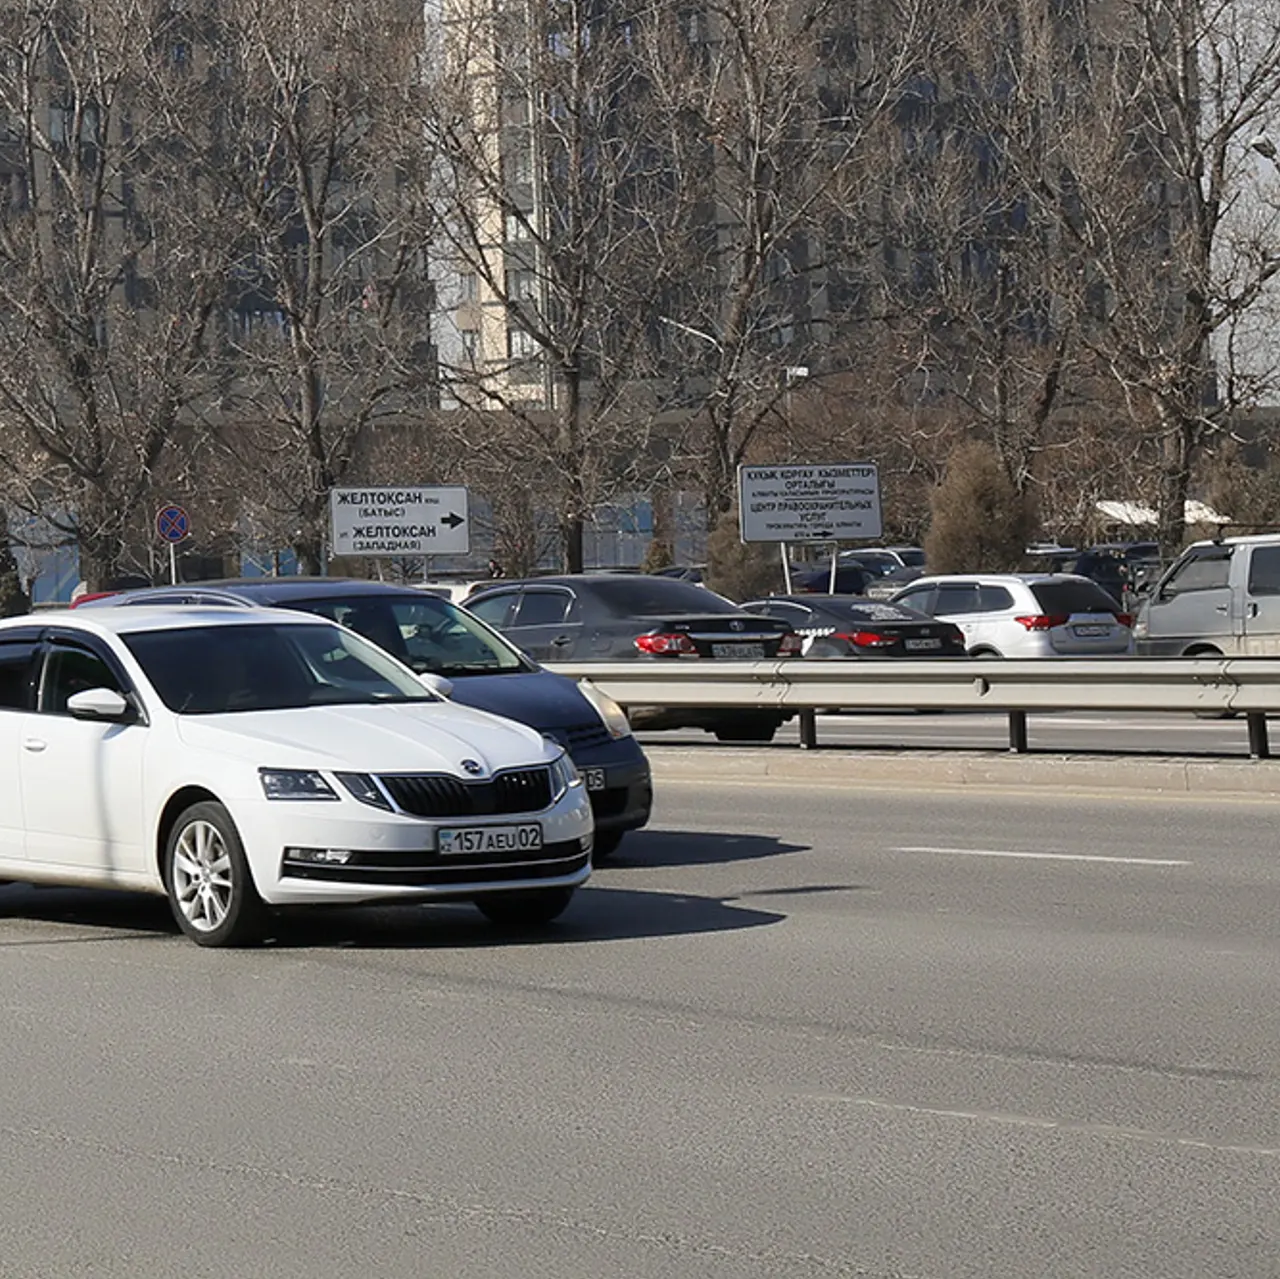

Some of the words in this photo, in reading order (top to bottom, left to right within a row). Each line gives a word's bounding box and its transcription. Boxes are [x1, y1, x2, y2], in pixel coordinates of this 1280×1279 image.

[358, 507, 407, 518] (БАТЫС)
[352, 525, 437, 539] ЖЕЛТОКСАН
[352, 540, 422, 551] (ЗАПАДНАЯ)
[454, 830, 484, 851] 157
[486, 833, 517, 850] AEU
[518, 827, 541, 848] 02
